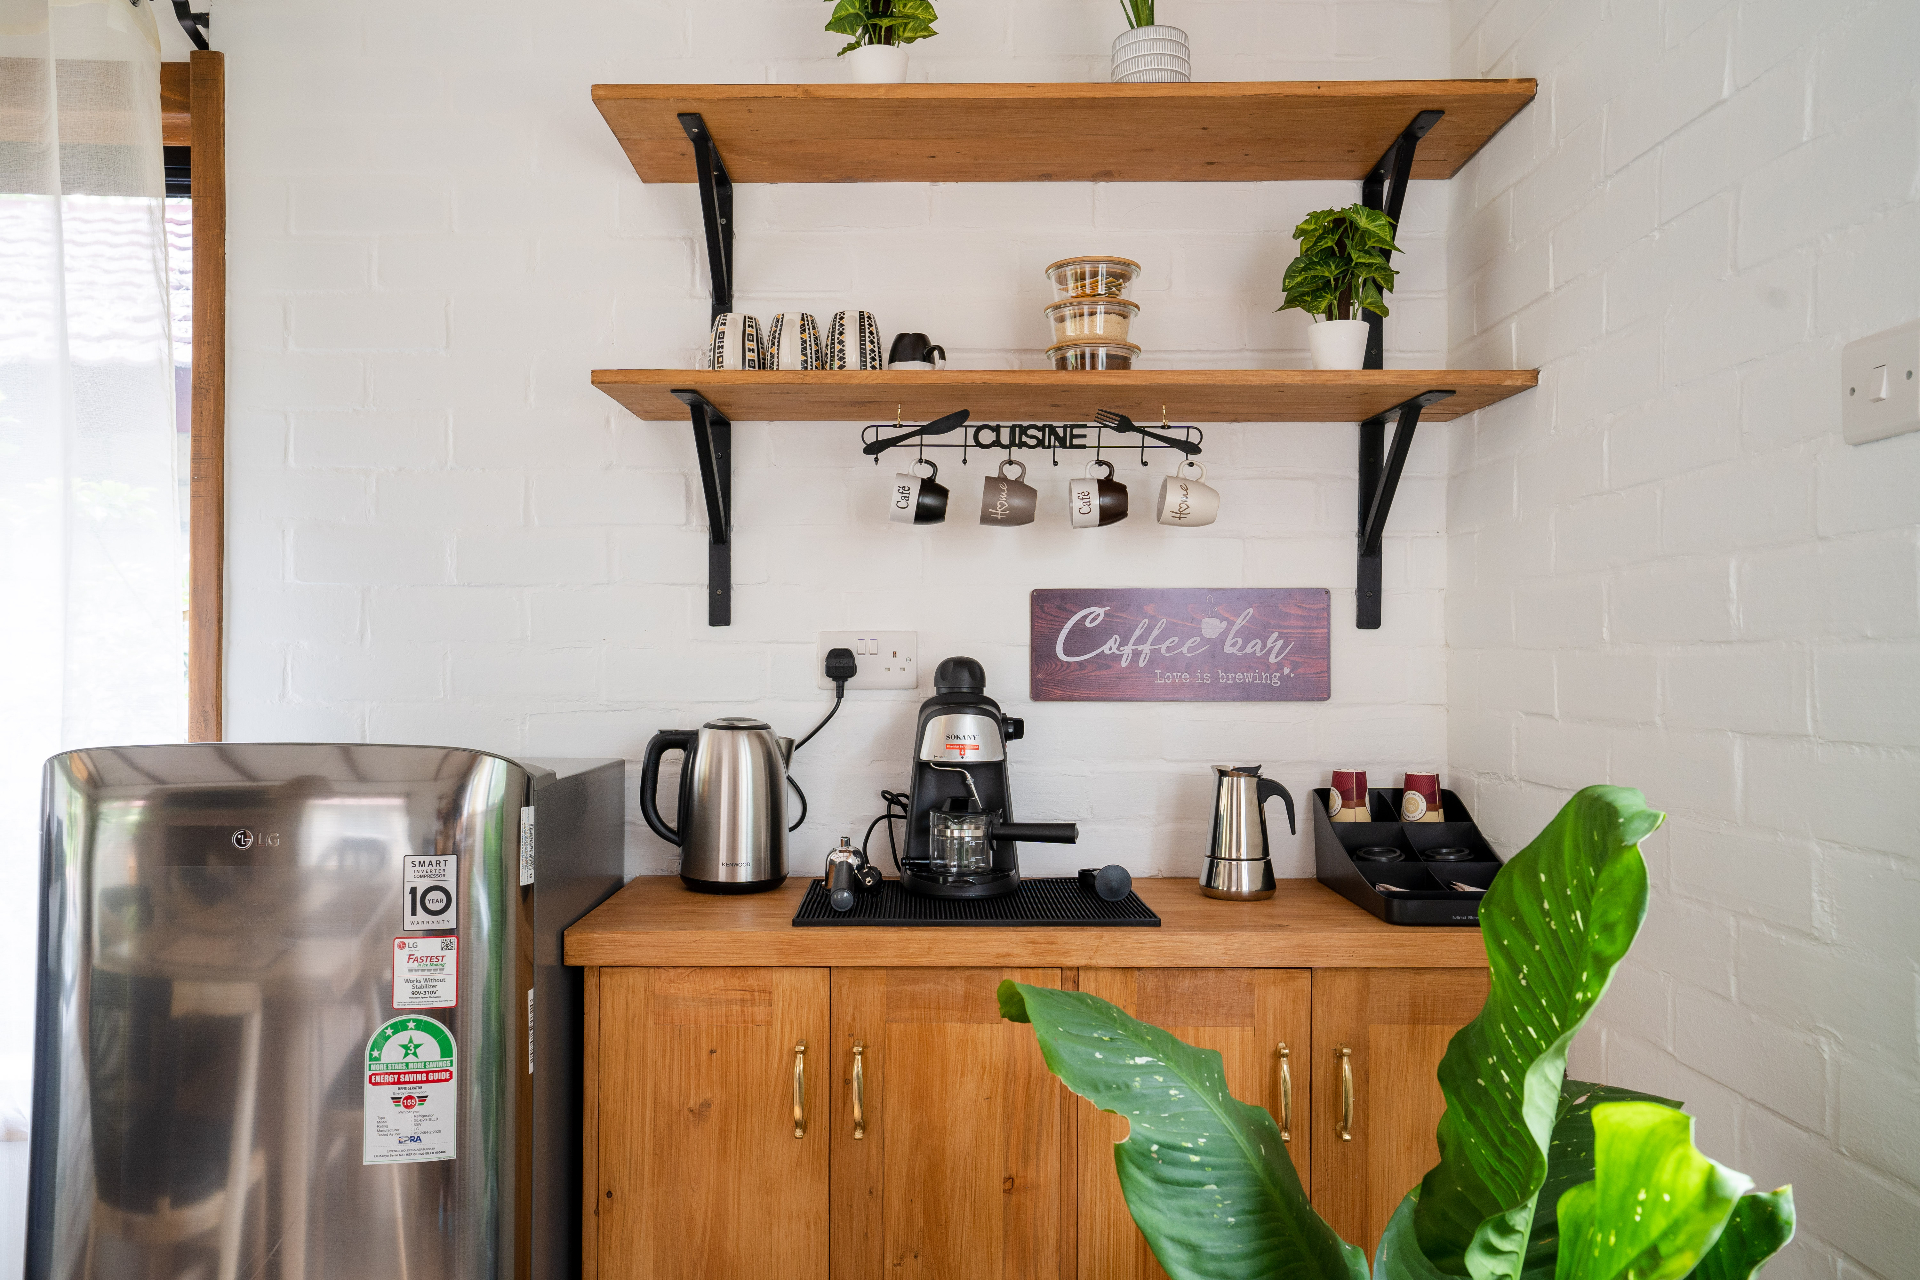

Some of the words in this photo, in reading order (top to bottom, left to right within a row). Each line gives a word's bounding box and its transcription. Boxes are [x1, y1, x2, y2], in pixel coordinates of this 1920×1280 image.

[973, 424, 1087, 449] CUISINE
[896, 485, 911, 509] Café
[1077, 490, 1091, 515] Café
[1056, 606, 1209, 667] Coffee
[1224, 608, 1294, 663] bar
[1154, 670, 1190, 683] Love
[1195, 670, 1211, 683] is
[1217, 669, 1281, 686] brewing
[256, 832, 279, 847] LG
[409, 885, 452, 916] 10
[407, 953, 446, 963] FASTEST
[407, 1043, 415, 1054] 3
[408, 1061, 424, 1069] MORE
[425, 1060, 451, 1068] SAVINGS
[371, 1074, 398, 1083] ENERGY
[400, 1072, 426, 1082] SAVING
[428, 1071, 450, 1080] GUIDE
